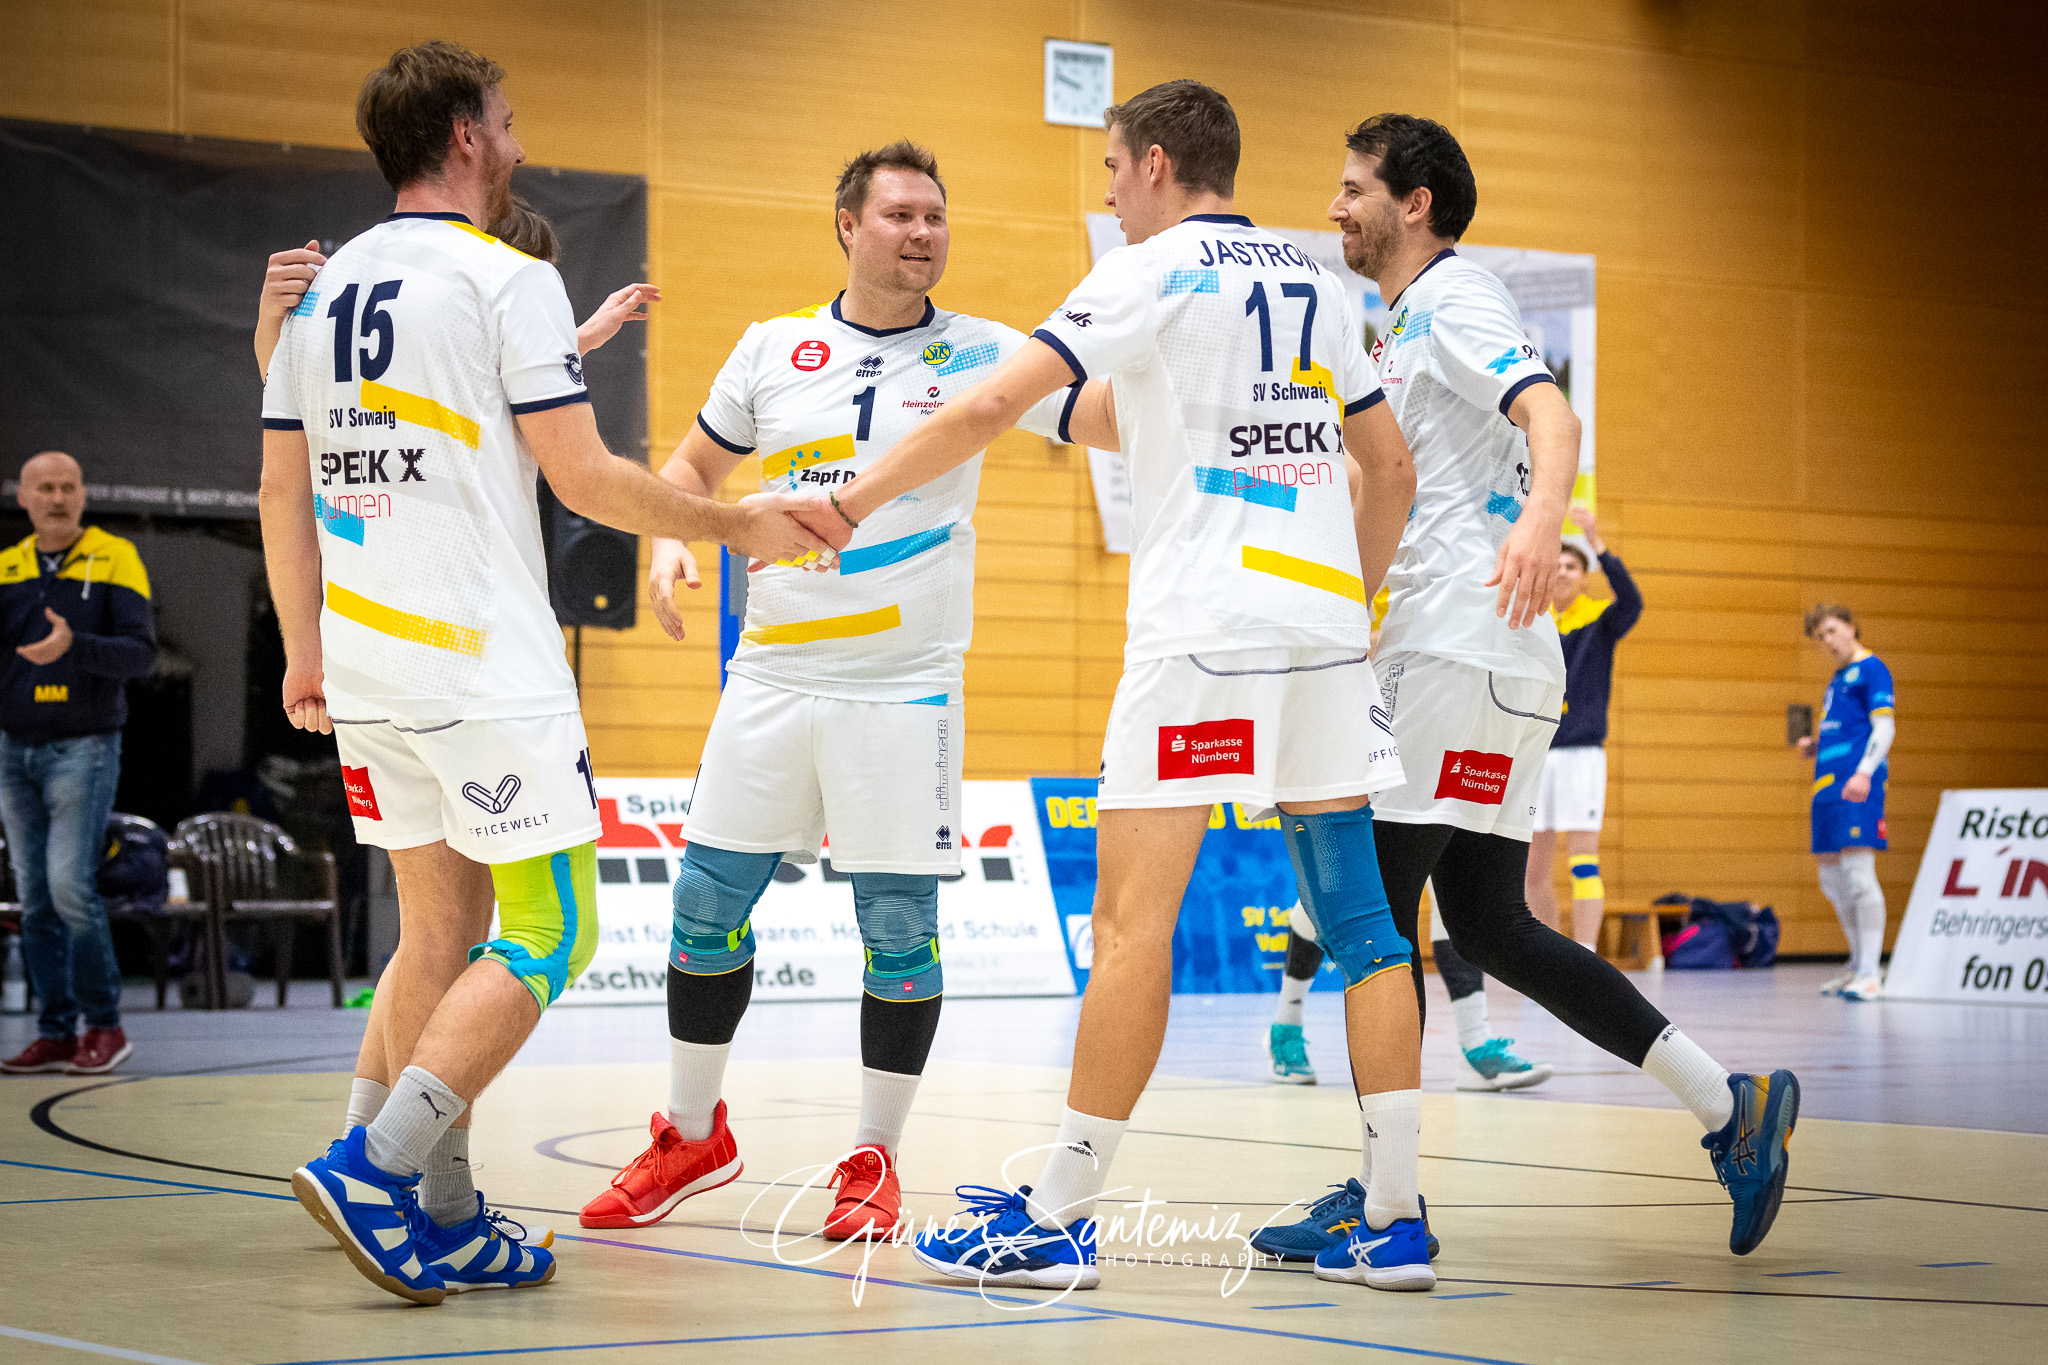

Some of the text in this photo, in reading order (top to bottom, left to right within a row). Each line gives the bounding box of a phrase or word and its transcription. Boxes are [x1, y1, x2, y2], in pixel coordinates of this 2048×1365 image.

[327, 280, 404, 383] 15
[1245, 281, 1318, 372] 17
[1253, 383, 1266, 402] SV
[329, 407, 343, 428] SV
[852, 386, 876, 442] 1
[1229, 421, 1330, 457] SPECK
[800, 468, 840, 486] Zapf
[34, 684, 69, 703] MM
[1190, 737, 1243, 752] Sparkasse
[1191, 751, 1240, 764] Nürnberg
[1961, 954, 2048, 992] fon 0
[1067, 1145, 1097, 1158] adida
